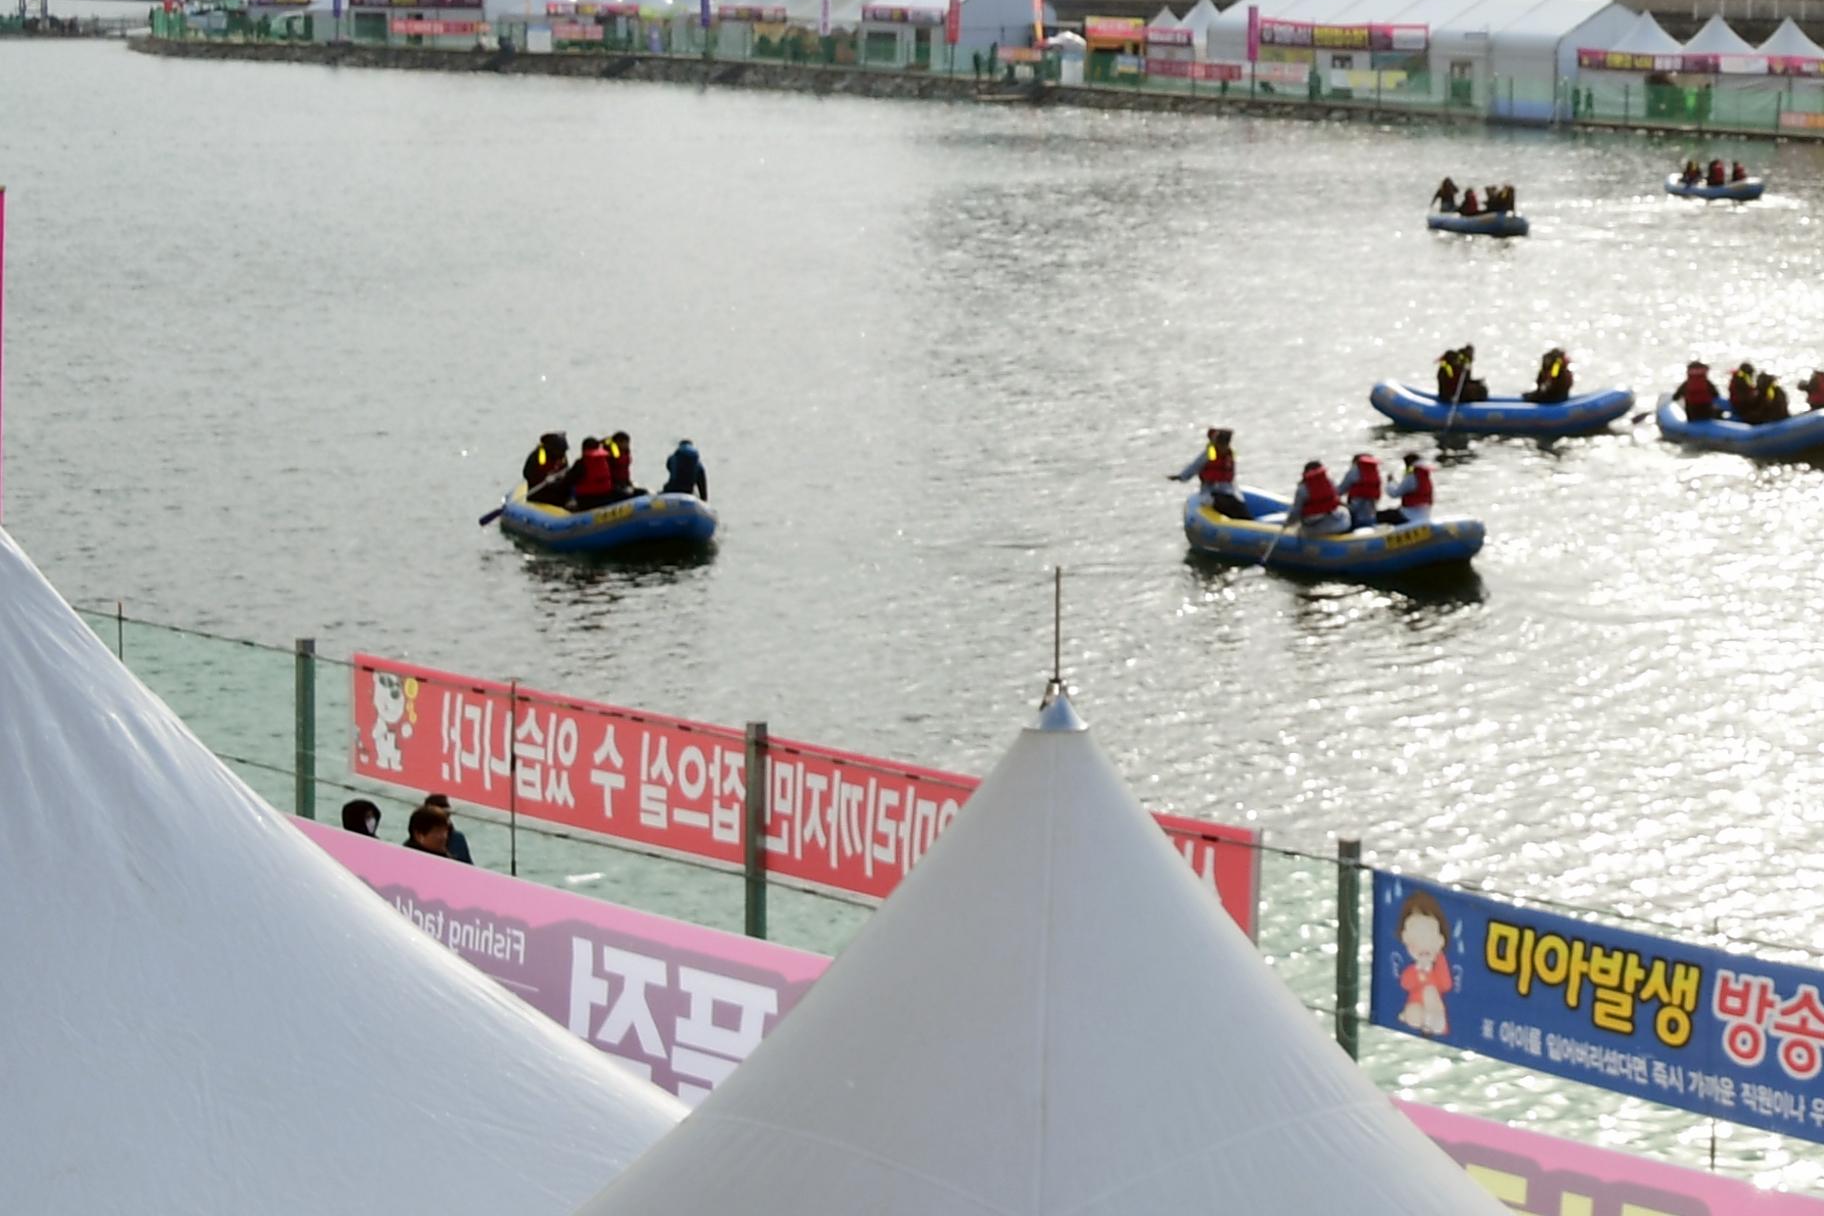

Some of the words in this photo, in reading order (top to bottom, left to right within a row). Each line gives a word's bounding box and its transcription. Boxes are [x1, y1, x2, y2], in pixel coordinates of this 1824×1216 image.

[1485, 919, 1703, 1048] 미아발생
[1500, 1020, 1542, 1056] 아이를
[1651, 1060, 1685, 1094] 즉시
[1741, 1082, 1805, 1123] 직원이나
